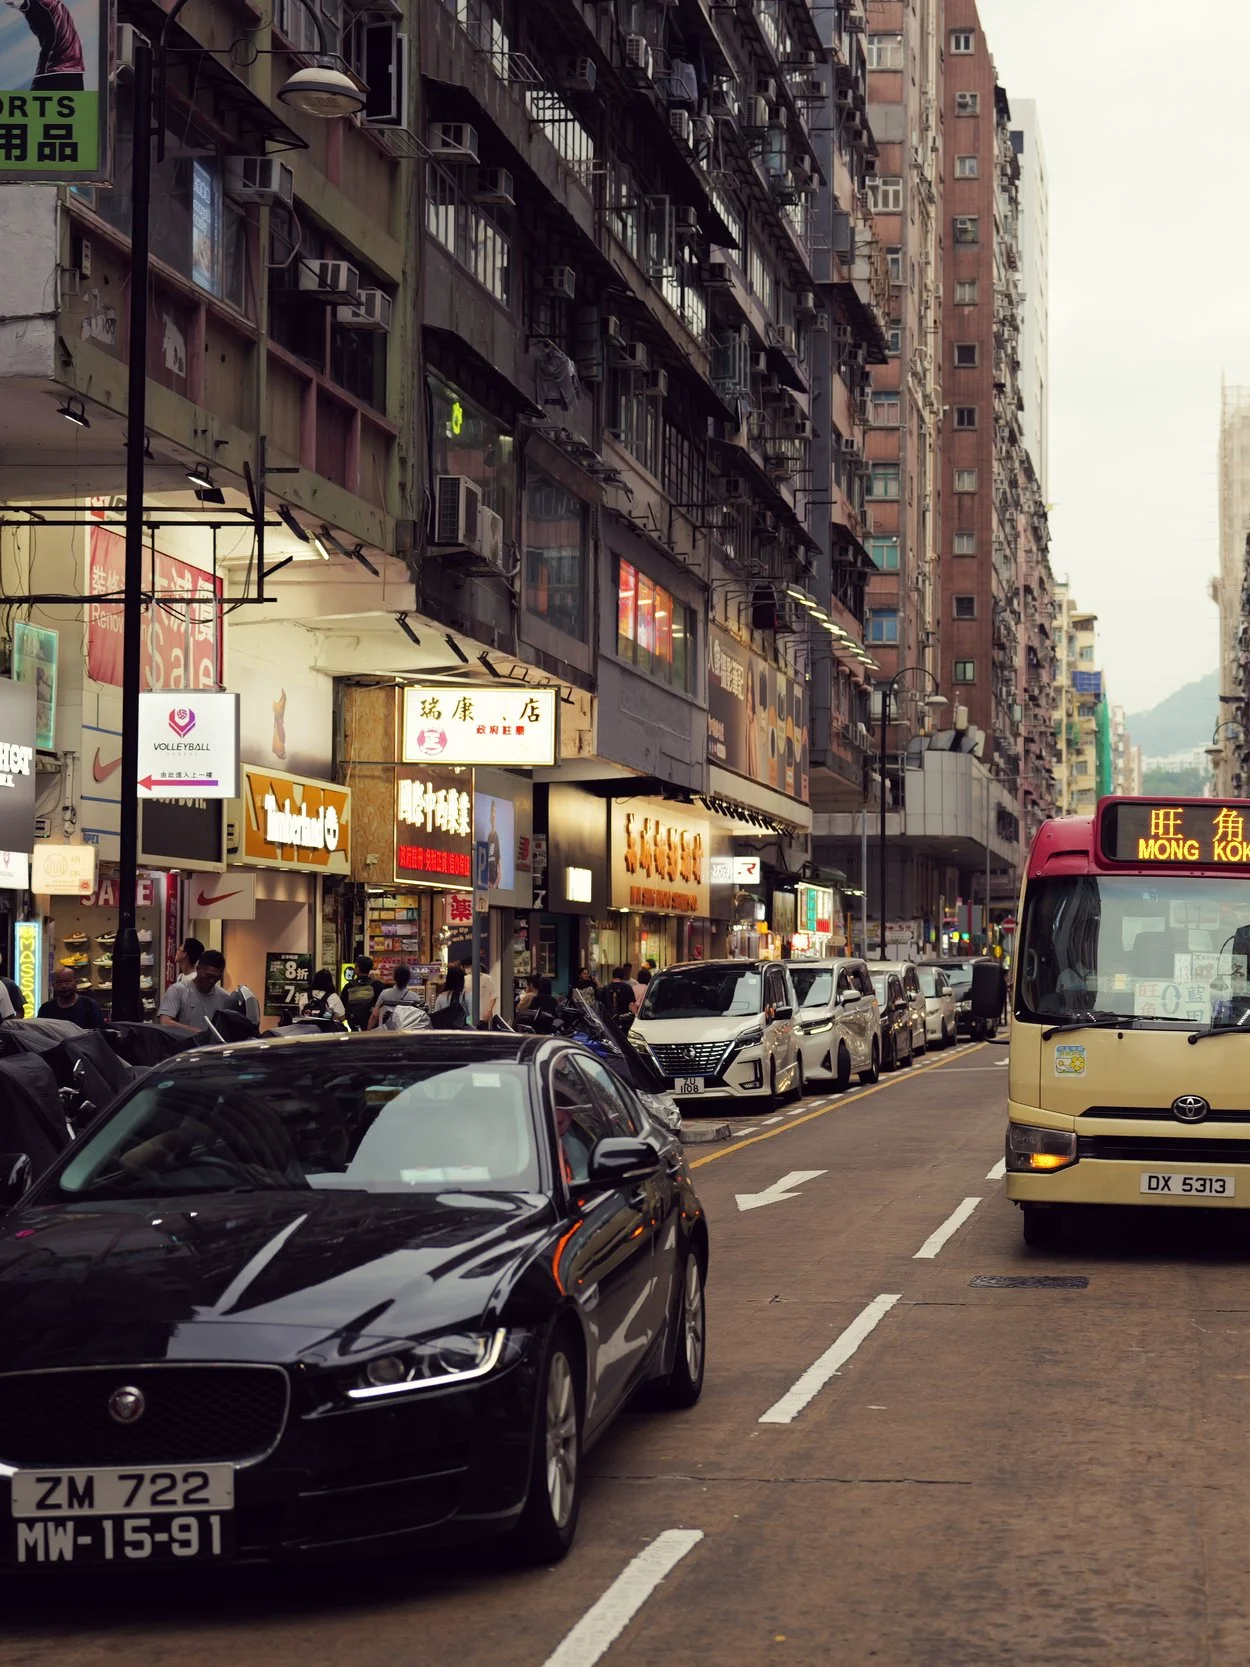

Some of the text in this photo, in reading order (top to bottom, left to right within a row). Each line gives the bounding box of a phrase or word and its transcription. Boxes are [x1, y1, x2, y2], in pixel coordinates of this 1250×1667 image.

[0, 95, 76, 118] RTS
[0, 123, 79, 163] 用品
[146, 622, 214, 689] Sale
[420, 696, 541, 723] 瑞康店
[153, 742, 211, 751] VOLLEYBALL
[1151, 807, 1245, 844] 旺角
[1138, 839, 1200, 861] MONG
[82, 879, 152, 906] AE
[680, 1085, 699, 1094] 1108
[683, 1077, 696, 1085] ZU
[1147, 1175, 1226, 1194] DX 5313
[34, 1471, 210, 1511] ZM 722
[16, 1515, 222, 1563] MW-15-91
